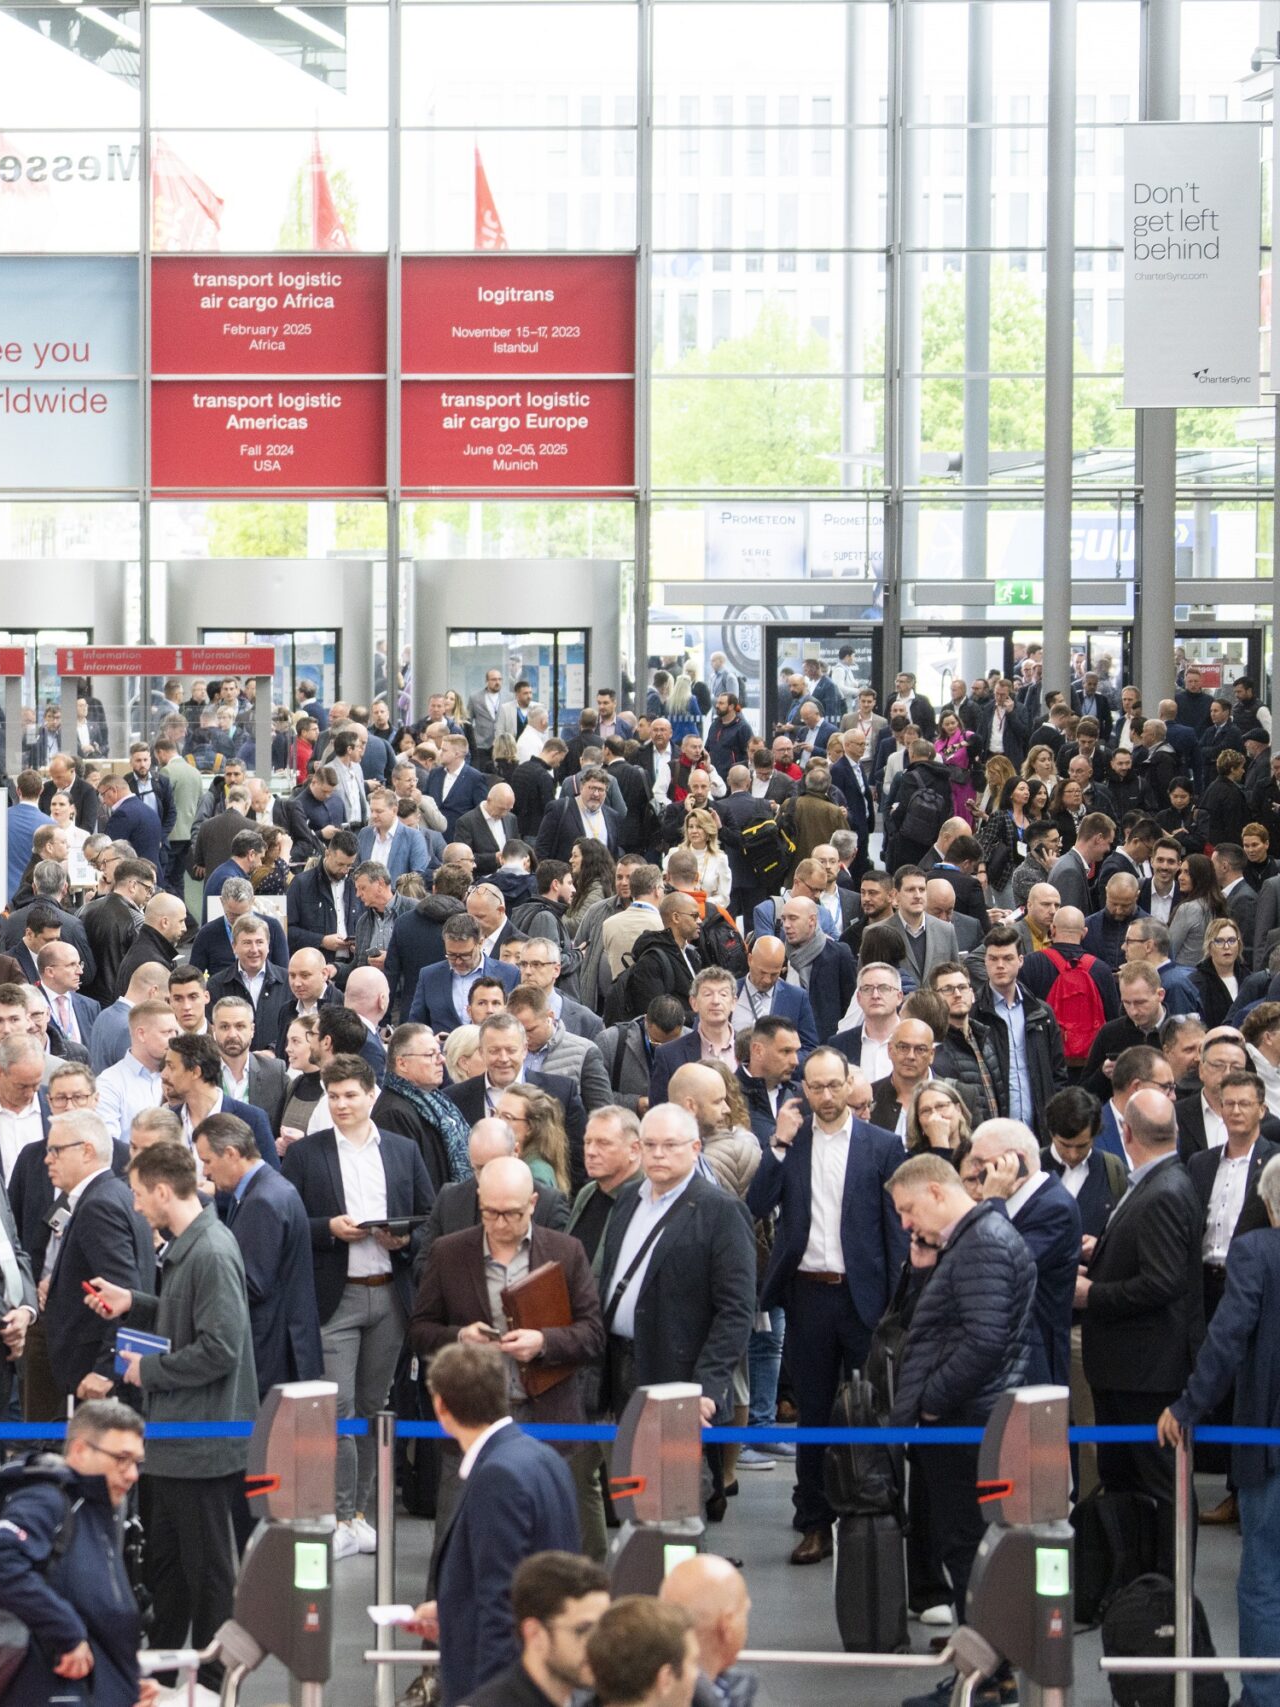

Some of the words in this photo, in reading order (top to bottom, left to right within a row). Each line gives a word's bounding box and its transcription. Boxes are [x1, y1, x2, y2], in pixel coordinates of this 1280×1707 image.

[1133, 211, 1174, 237] get
[1180, 208, 1220, 232] left
[1133, 236, 1220, 261] behind
[192, 272, 274, 290] transport
[278, 271, 342, 291] logistic
[1134, 271, 1209, 281] CharterSync.com
[200, 293, 224, 309] air
[227, 296, 279, 312] cargo
[282, 293, 335, 309] Africa
[477, 286, 555, 306] logitrans
[223, 323, 279, 338] February
[282, 323, 312, 336] 2025
[451, 326, 512, 338] November
[551, 325, 581, 338] 2023
[248, 338, 286, 351] Africa
[493, 341, 539, 354] Istanbul
[33, 341, 90, 369] you
[1198, 375, 1252, 385] CharterSync
[192, 393, 274, 411] transport
[278, 392, 342, 412] logistic
[440, 392, 522, 411] transport
[526, 391, 590, 411] logistic
[225, 414, 308, 430] Americas
[442, 413, 466, 429] air
[470, 416, 521, 433] cargo
[525, 413, 589, 432] Europe
[239, 444, 262, 457] Fall
[265, 444, 295, 457] 2024
[463, 443, 494, 456] June
[539, 443, 568, 456] 2025
[253, 459, 282, 472] USA
[492, 459, 539, 471] Munich
[720, 511, 796, 525] PROMETEON
[82, 650, 142, 660] Information
[191, 650, 251, 660] Information
[82, 662, 142, 672] Information
[191, 662, 251, 672] Information
